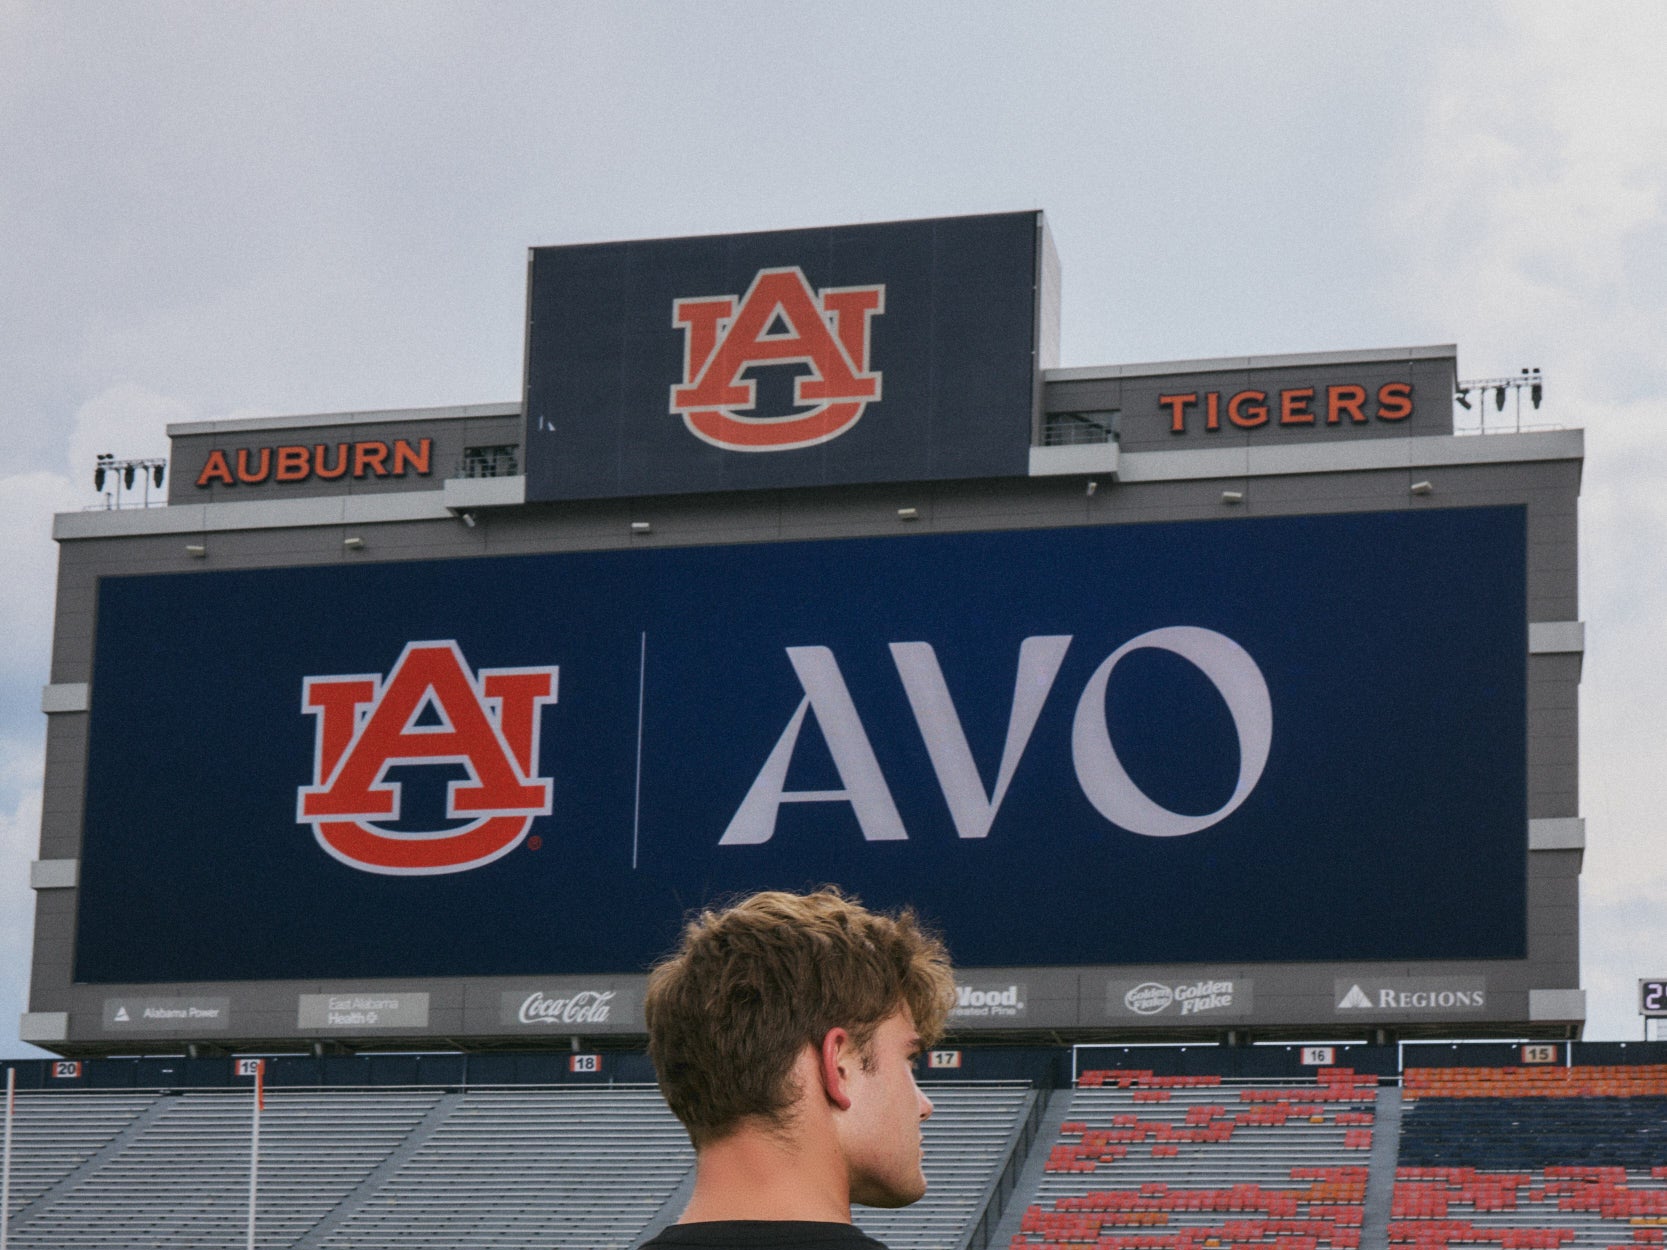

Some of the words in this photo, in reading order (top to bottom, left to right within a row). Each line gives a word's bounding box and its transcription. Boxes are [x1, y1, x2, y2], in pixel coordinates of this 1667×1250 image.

[1158, 382, 1413, 432] TIGERS
[196, 438, 432, 485] AUBURN
[718, 625, 1273, 845] AVO
[1174, 981, 1233, 1000] Golden
[1379, 989, 1485, 1008] REGIONS
[144, 1008, 187, 1018] Alabama
[189, 1007, 219, 1018] Power
[519, 991, 616, 1023] Coca-Cola
[1181, 994, 1232, 1015] Flake
[935, 1053, 954, 1065] 17
[1311, 1050, 1325, 1062] 16
[1529, 1047, 1549, 1060] 15
[58, 1063, 77, 1075] 20
[241, 1061, 258, 1073] 19
[576, 1057, 595, 1070] 18
